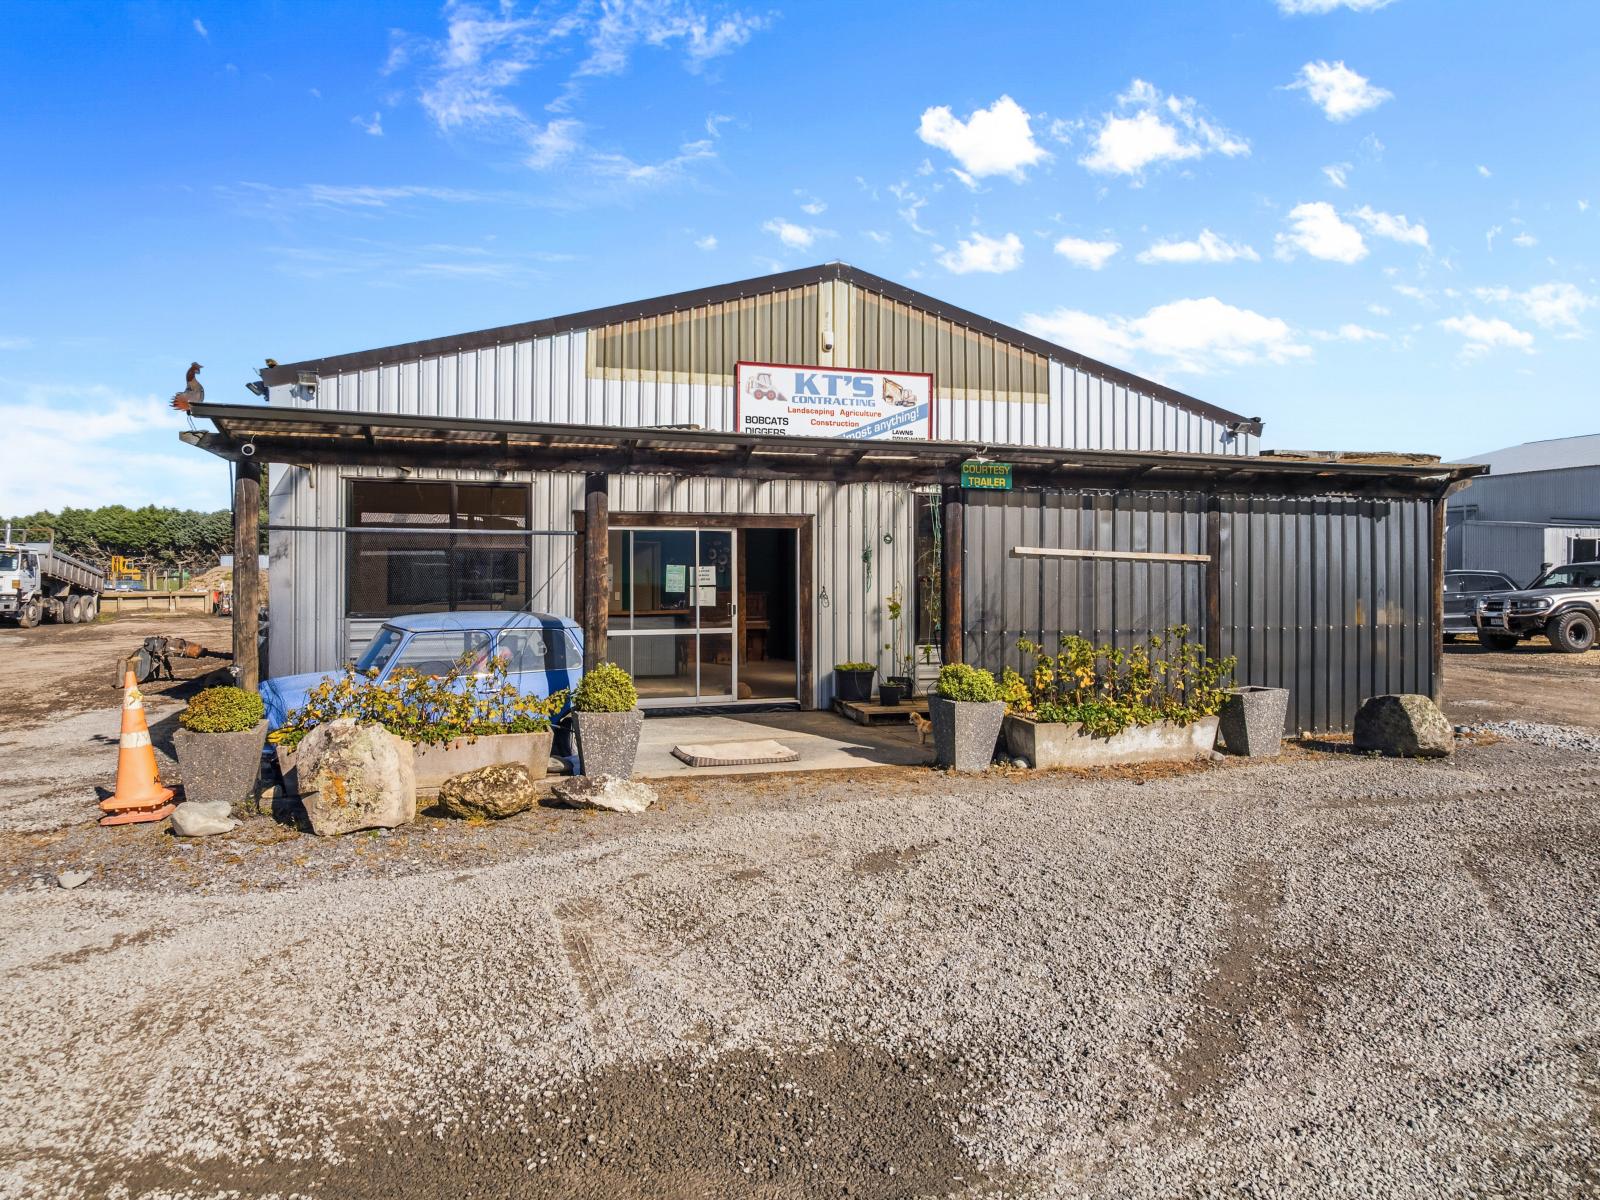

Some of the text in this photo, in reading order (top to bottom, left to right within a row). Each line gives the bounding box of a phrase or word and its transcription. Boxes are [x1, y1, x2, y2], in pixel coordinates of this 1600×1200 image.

[794, 372, 874, 398] KT'S
[791, 395, 876, 407] CONTRACTING
[787, 406, 882, 418] Landscaping Agriculture
[745, 415, 789, 426] BOBCATS
[810, 418, 859, 428] Construction
[874, 406, 920, 432] anything!
[745, 427, 786, 436] DIGGERS
[962, 464, 1010, 475] COURTESY
[968, 476, 1006, 487] TRAILER
